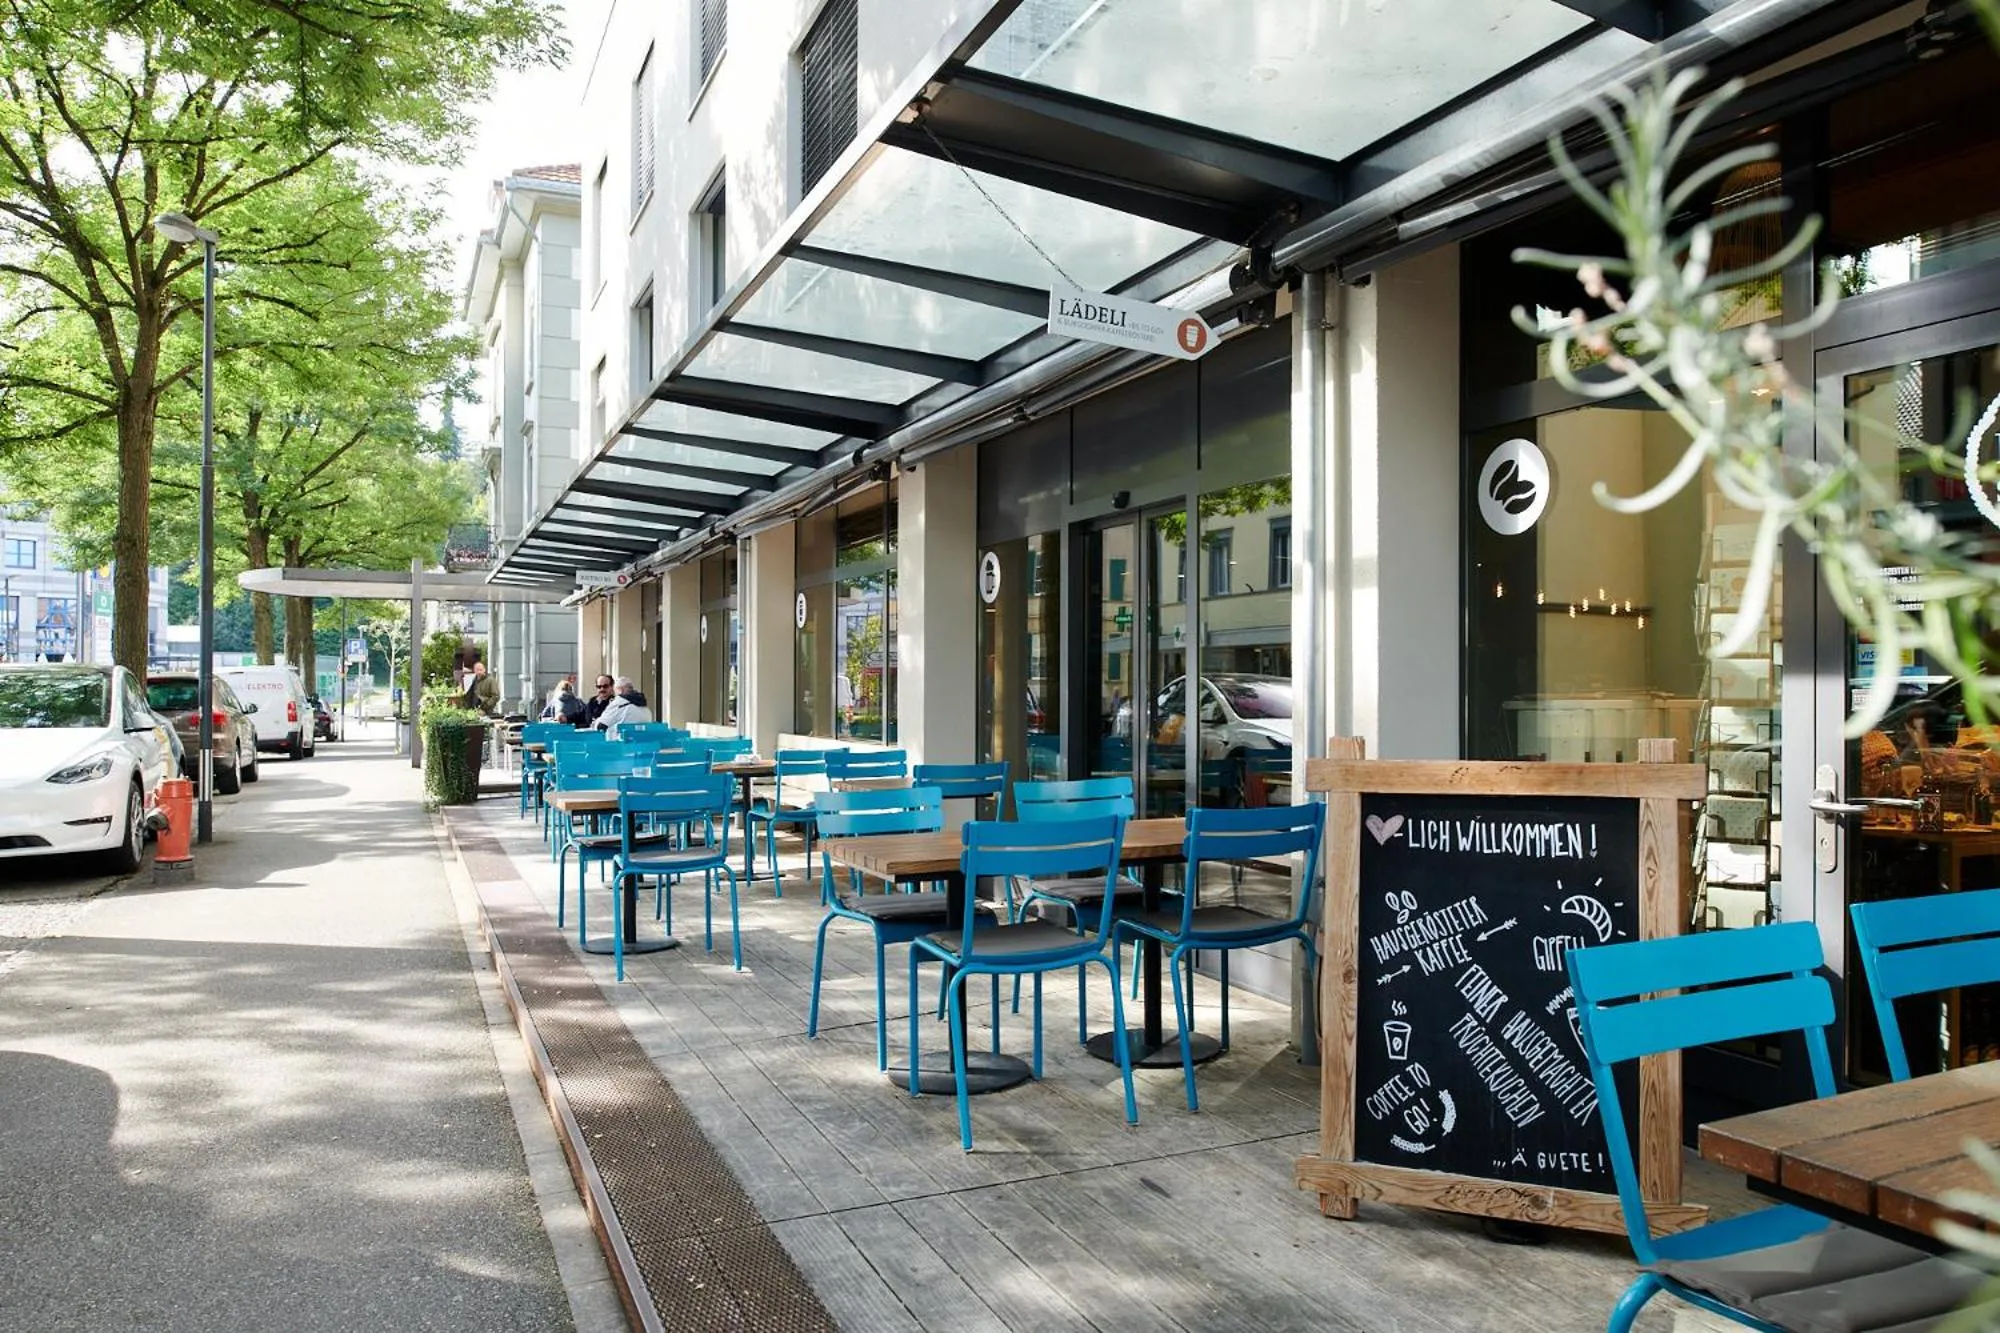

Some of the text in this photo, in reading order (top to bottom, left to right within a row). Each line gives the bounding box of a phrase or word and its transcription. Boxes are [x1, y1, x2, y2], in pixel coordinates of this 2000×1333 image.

[1059, 298, 1127, 327] LÄDELI
[248, 683, 284, 691] ELEKTRO
[1369, 896, 1489, 964] HAUSGERÖSTETER
[1414, 933, 1473, 976] KAFFEE
[1533, 935, 1586, 971] GIPF
[1454, 963, 1509, 1024] FEINER
[1366, 1062, 1431, 1121] COFFEE TO
[1449, 1012, 1546, 1128] FRÜCHTEKUCHEN
